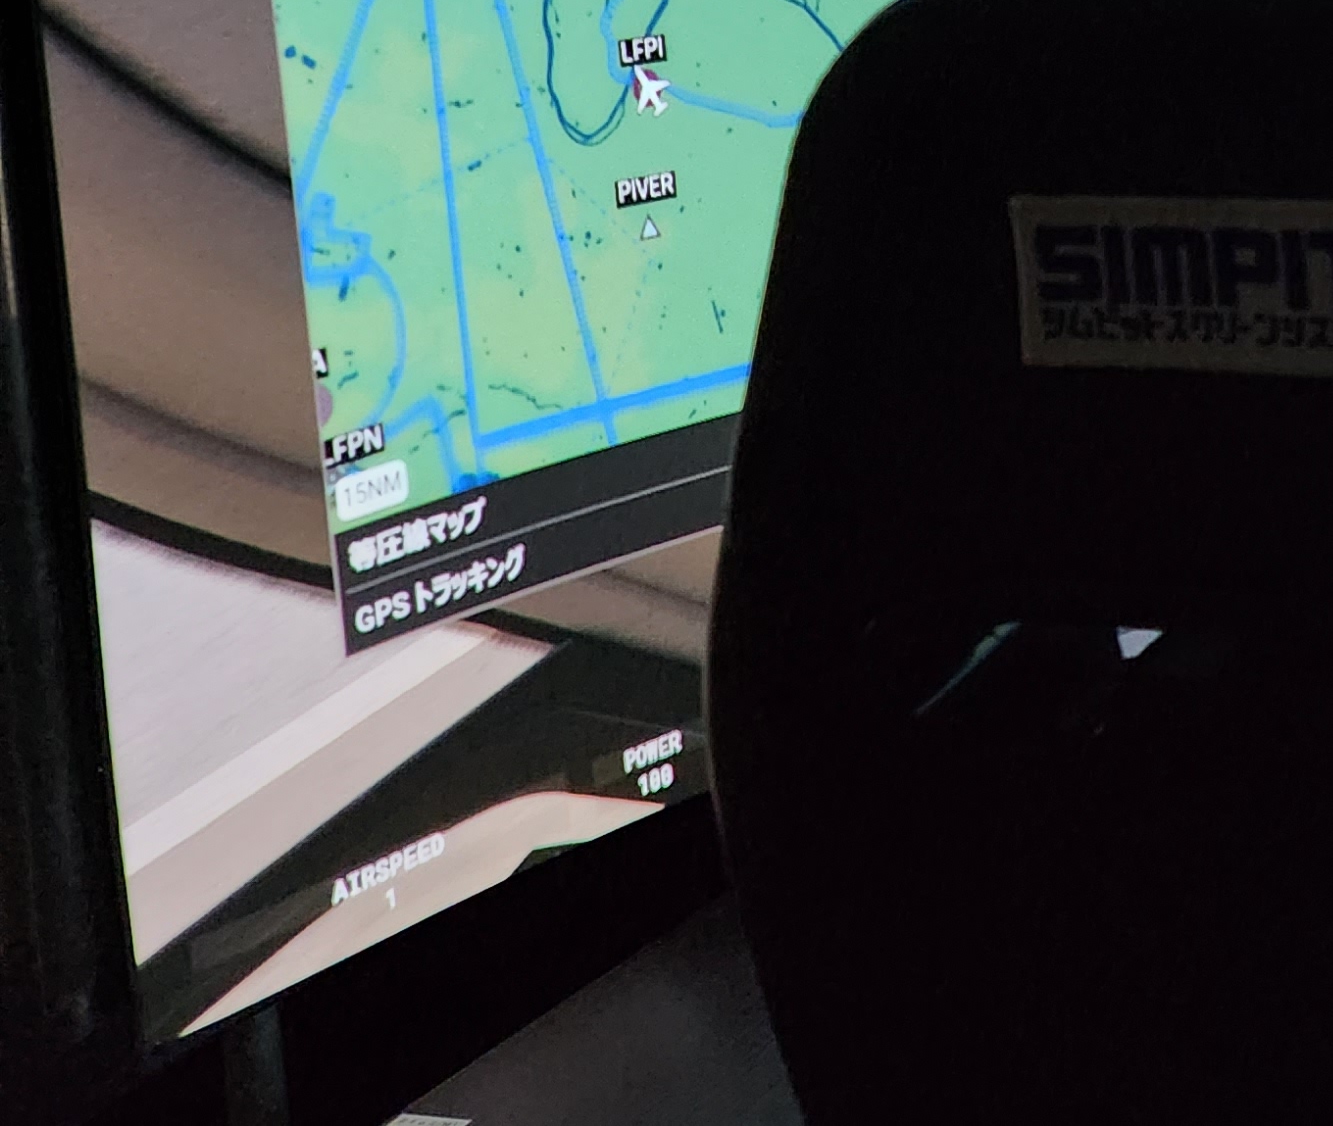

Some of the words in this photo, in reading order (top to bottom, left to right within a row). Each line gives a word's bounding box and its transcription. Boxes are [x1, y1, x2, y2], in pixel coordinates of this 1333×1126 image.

[620, 35, 664, 64] LFPI
[616, 174, 675, 203] PIVER
[325, 424, 382, 464] FPN
[343, 471, 402, 507] 15NM
[347, 496, 488, 573] 等圧線マップ
[354, 592, 411, 634] GPS
[414, 543, 527, 614] トラッキング
[622, 729, 683, 774] POWER
[637, 763, 674, 796] 100
[331, 831, 446, 907] AIRSPEED
